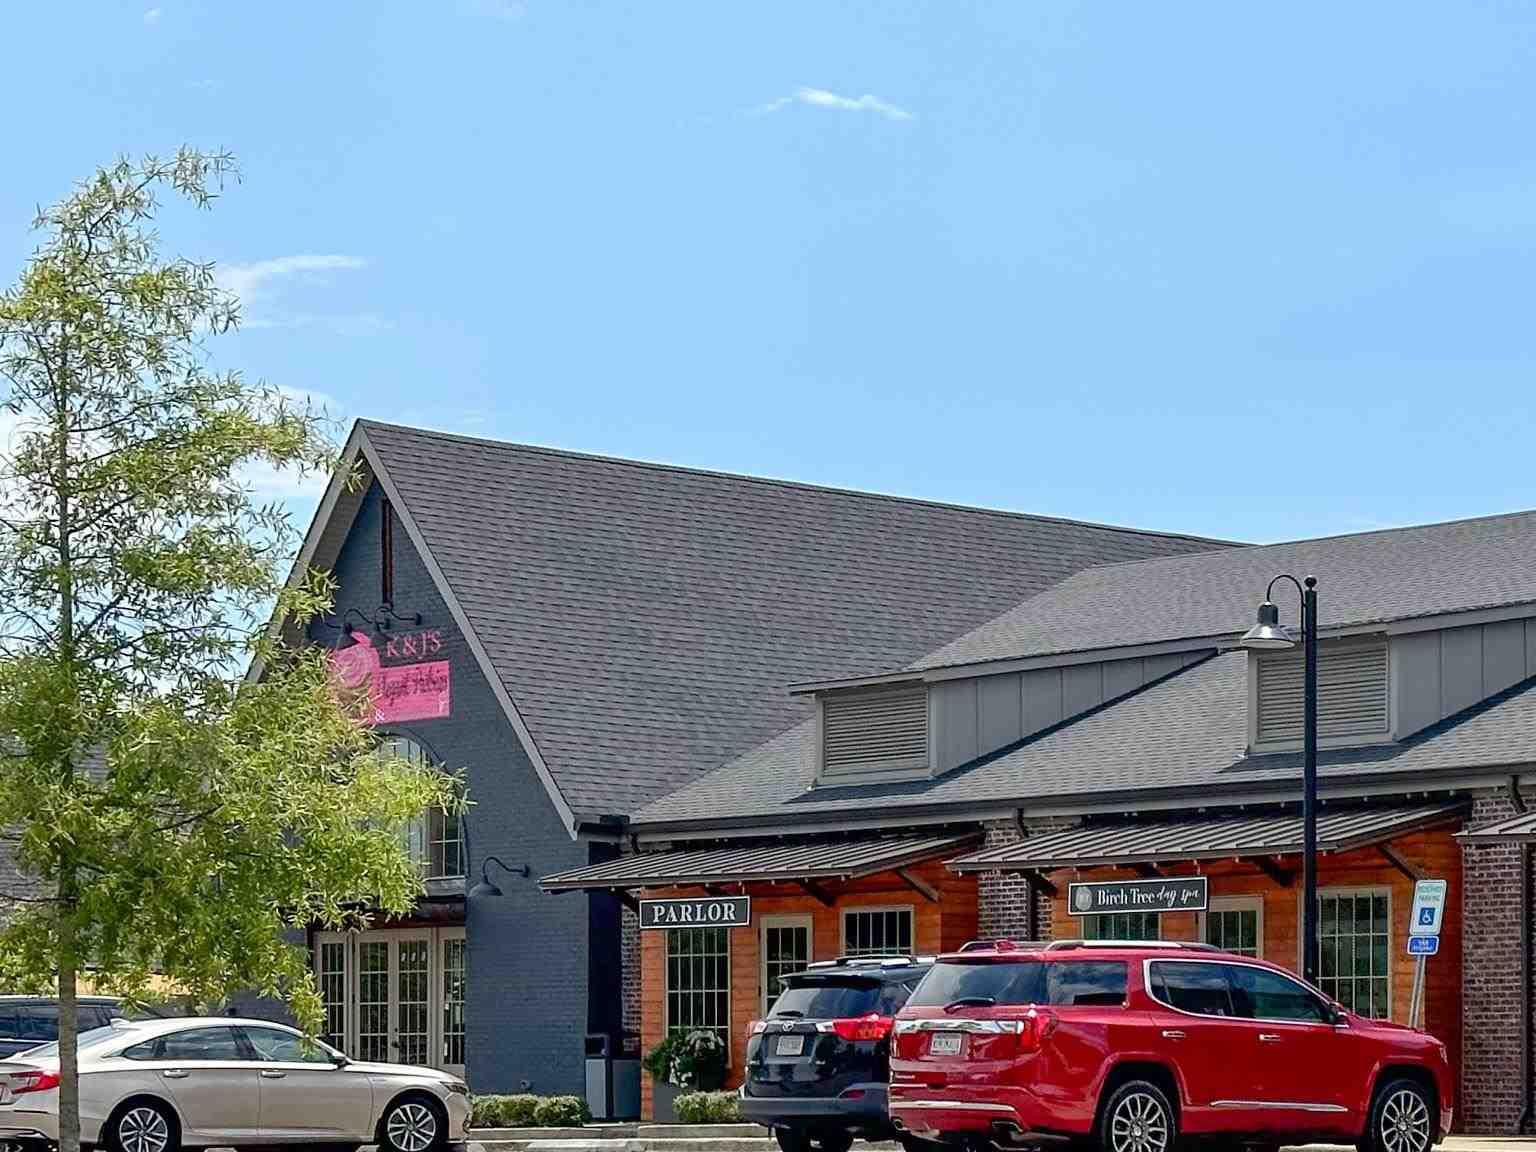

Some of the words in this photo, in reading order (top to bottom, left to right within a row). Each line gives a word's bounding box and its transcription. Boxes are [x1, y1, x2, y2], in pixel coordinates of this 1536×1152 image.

[1097, 887, 1128, 906] Birch
[1129, 887, 1155, 905] Tree
[652, 903, 736, 922] PARLOR
